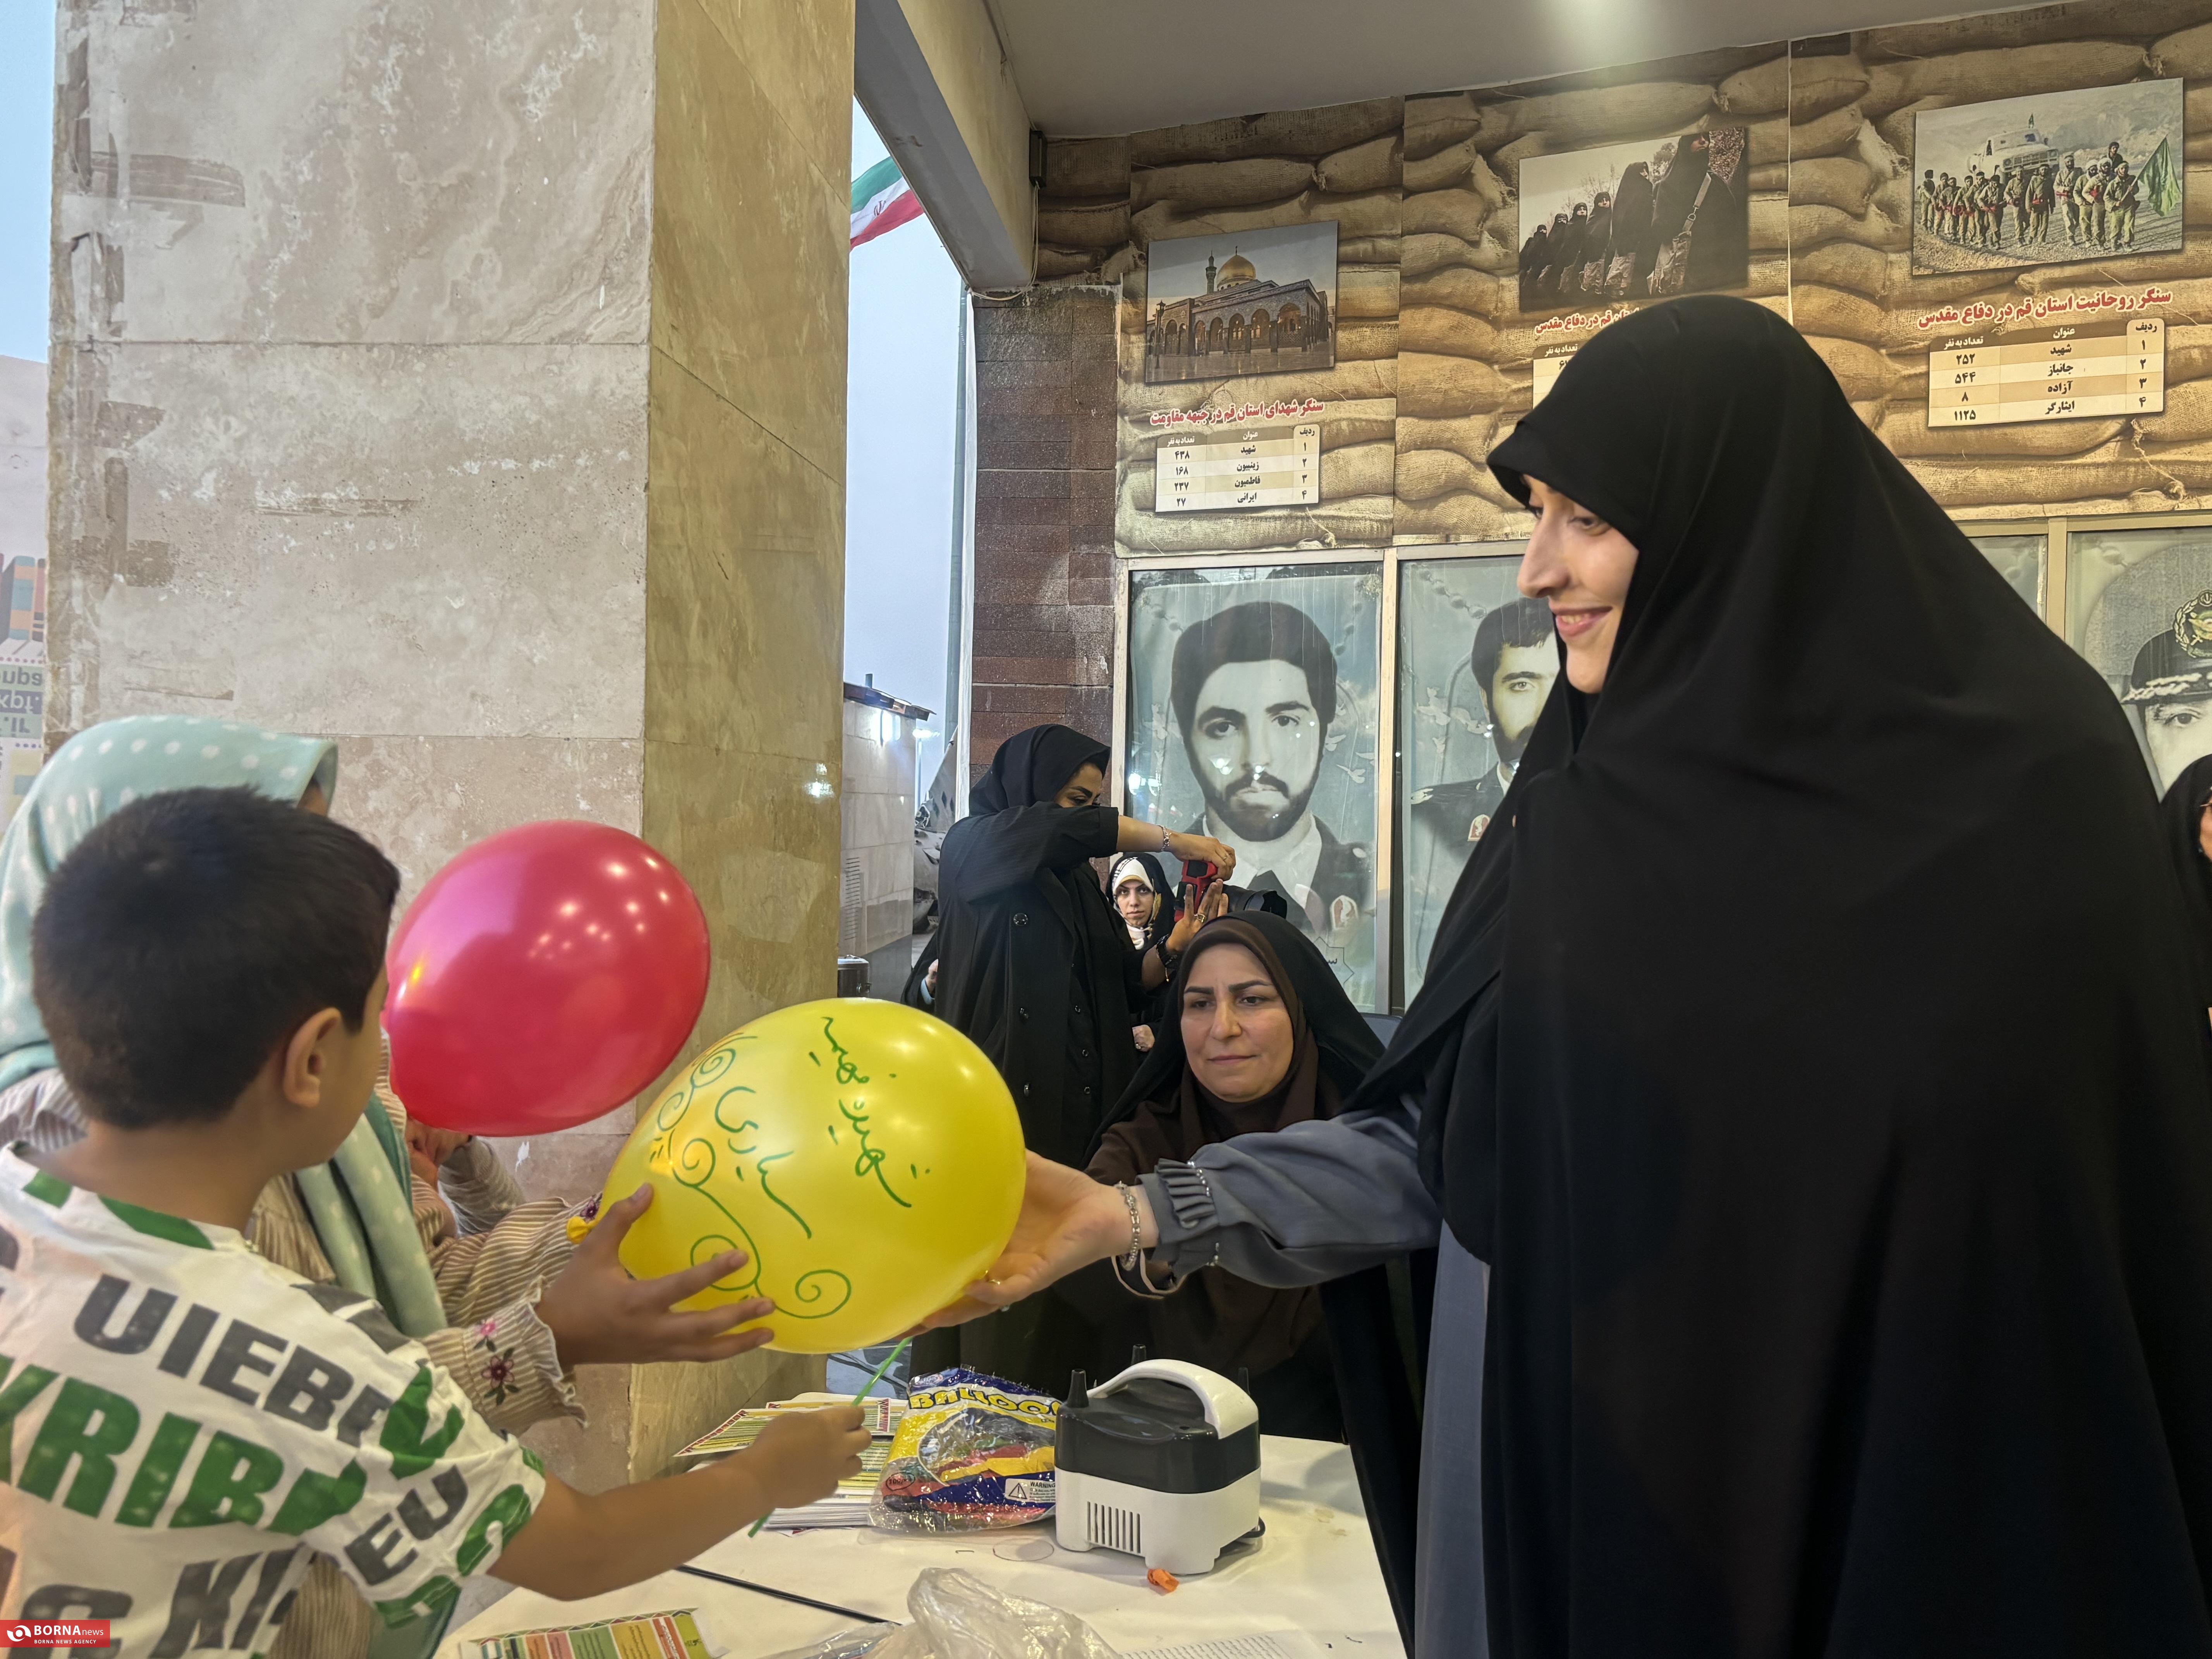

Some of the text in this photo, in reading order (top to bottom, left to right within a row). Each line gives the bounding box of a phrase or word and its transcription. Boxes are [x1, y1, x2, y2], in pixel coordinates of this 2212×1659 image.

[1918, 287, 2171, 328] سنگر روحانیت استان قم در دفاع مقدس
[1565, 314, 1585, 330] دفاع
[1587, 315, 1599, 328] در
[1601, 311, 1611, 327] قم
[1535, 317, 1562, 334] مقدس
[2135, 322, 2157, 332] ردیف
[2053, 328, 2075, 339] عنوان
[1944, 336, 1984, 350] تعداد به نفر
[2142, 340, 2145, 350] ۱
[1545, 344, 1578, 357] تعداد به نفر
[2050, 344, 2072, 356] شهید
[1956, 353, 1975, 365] ۲۵۲
[2140, 359, 2146, 370] ۲
[2048, 363, 2073, 376] جانباز
[1954, 371, 1976, 384] ۵۴۴
[2048, 380, 2073, 394] آزاده
[2139, 378, 2147, 389] ۳
[1961, 391, 1969, 402] ۸
[2045, 400, 2075, 414] ایثارگر
[2139, 397, 2146, 408] ۴
[1151, 398, 1324, 427] سنگر شهدای استان قم در جبهه مقاومت
[1954, 409, 1976, 421] ۱۱۲۵
[1242, 431, 1258, 440] عنوان
[1300, 427, 1315, 436] ردیف
[1241, 445, 1256, 454] شهید
[1304, 442, 1306, 451] ۱
[1175, 450, 1190, 460] ۴۳۸
[1302, 458, 1307, 467] ۲
[1176, 466, 1188, 476] ۱۶۸
[1235, 475, 1261, 488] فاطمیون
[1302, 474, 1307, 484] ۳
[1175, 482, 1189, 491] ۲۳۷
[1237, 492, 1257, 503] ایرانی
[1302, 490, 1307, 500] ۴
[1176, 498, 1186, 507] ۲۷
